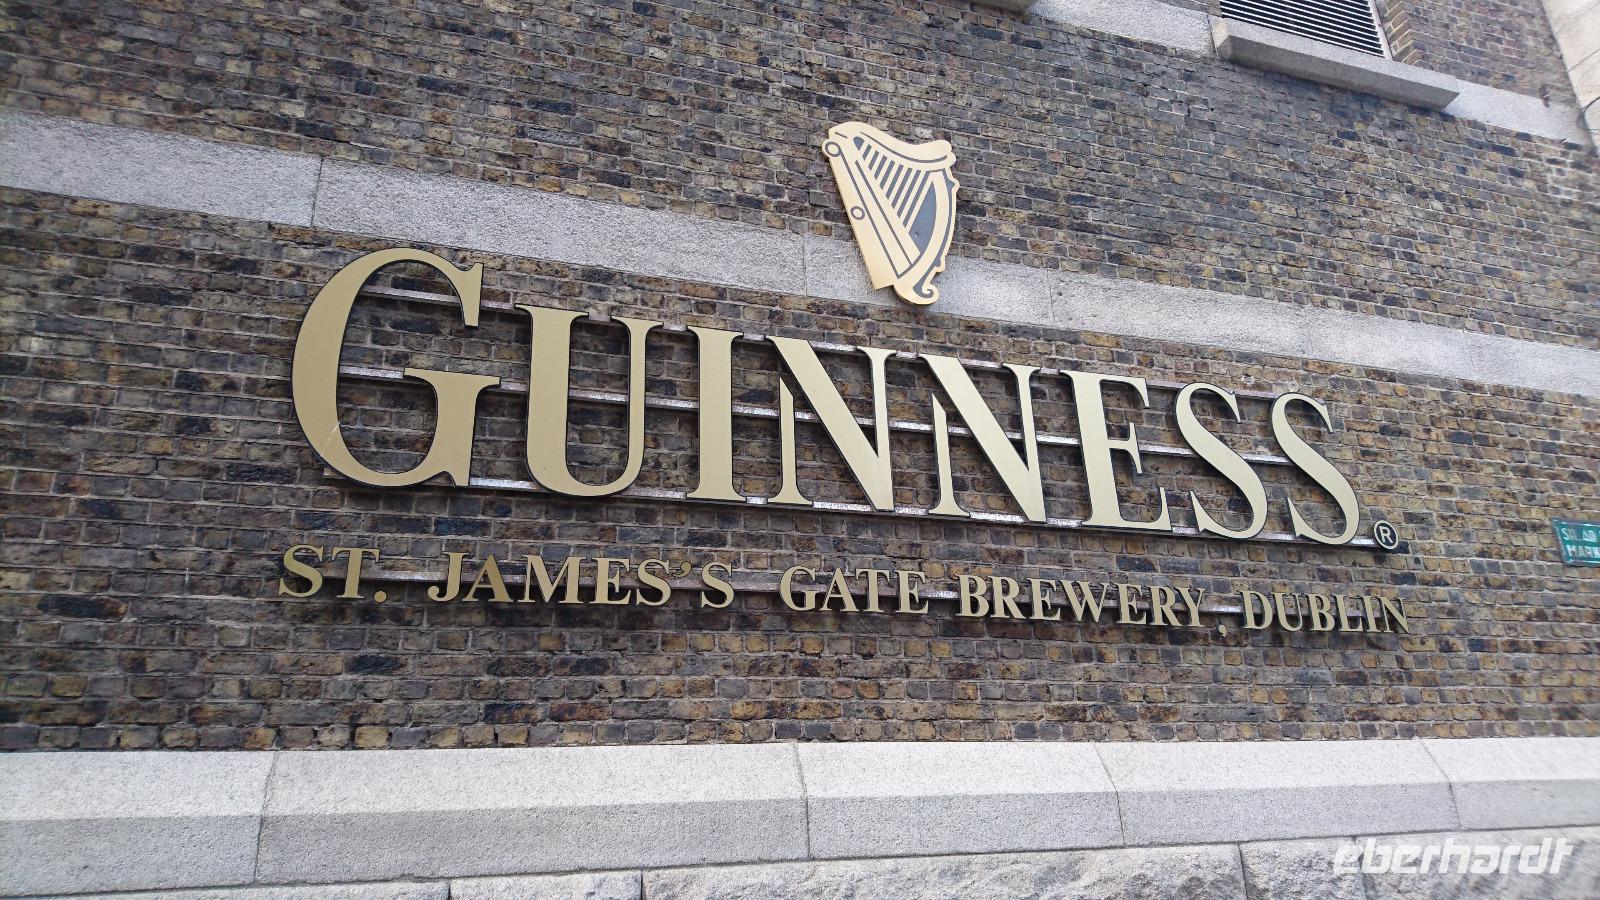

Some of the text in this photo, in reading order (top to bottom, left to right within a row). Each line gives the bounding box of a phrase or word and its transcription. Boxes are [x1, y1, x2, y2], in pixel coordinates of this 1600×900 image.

[292, 247, 1361, 546] GUINNESS
[278, 544, 388, 603] ST.
[427, 550, 735, 609] JAMES'S
[779, 564, 930, 615] GATE
[1238, 589, 1411, 634] DUBLIN
